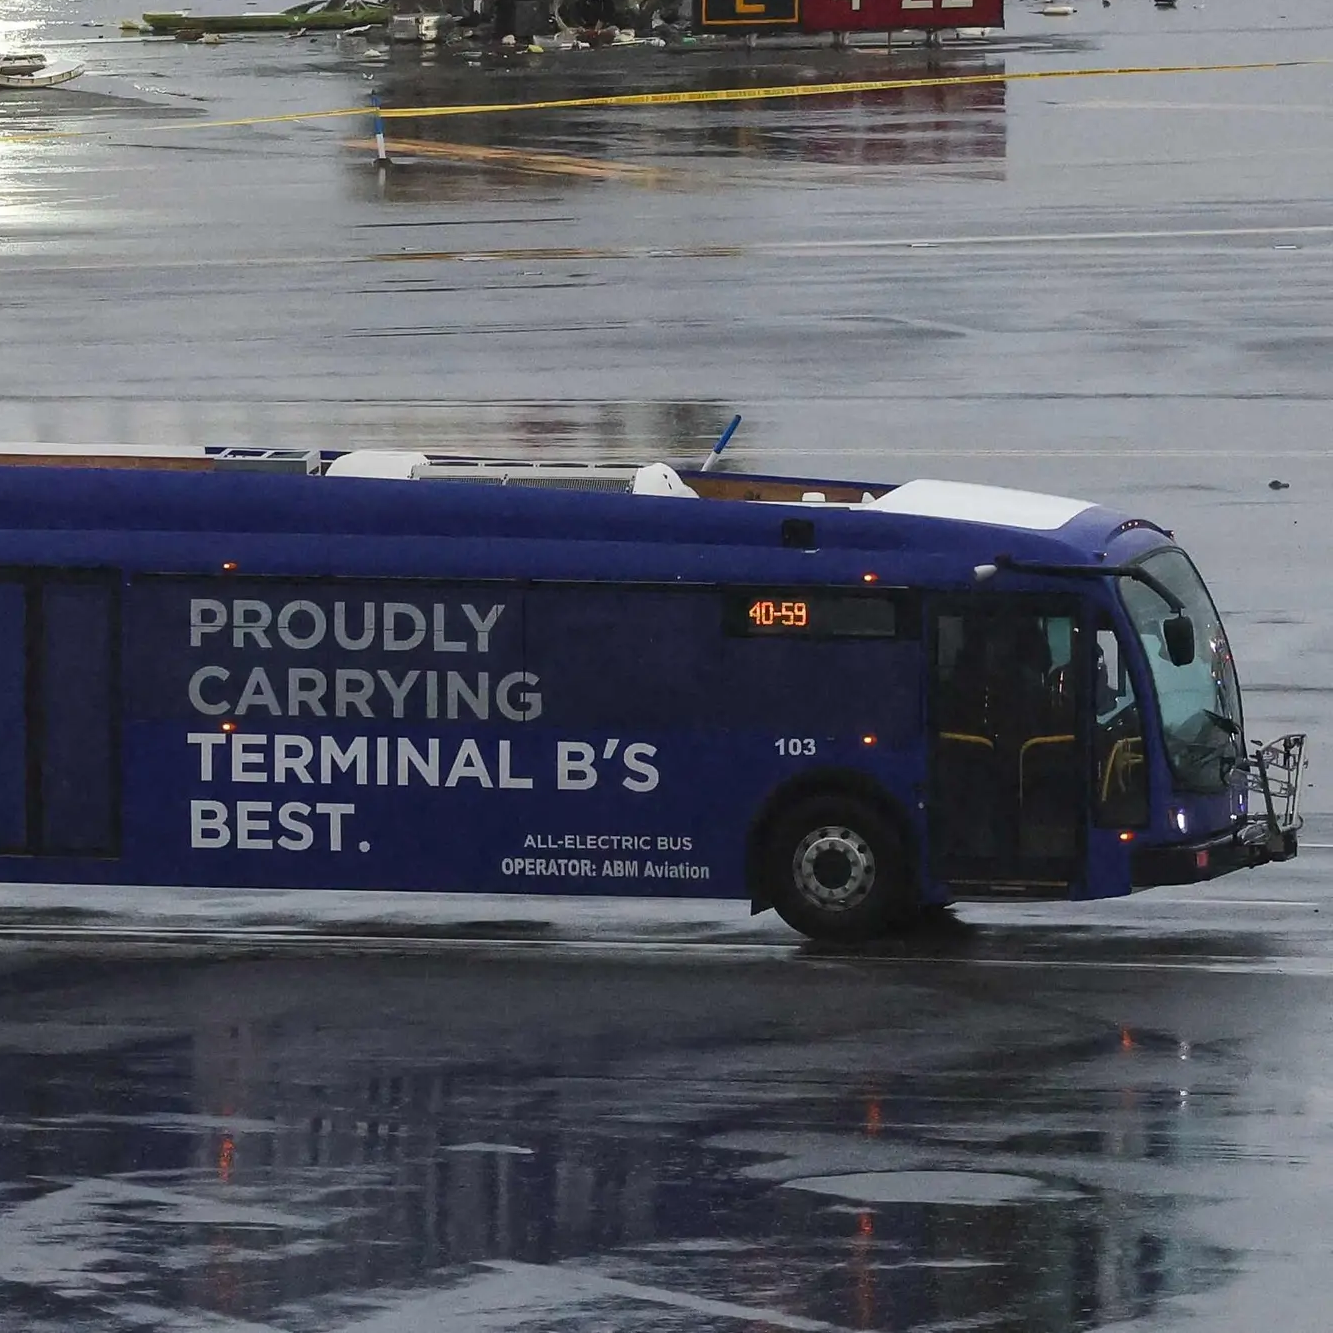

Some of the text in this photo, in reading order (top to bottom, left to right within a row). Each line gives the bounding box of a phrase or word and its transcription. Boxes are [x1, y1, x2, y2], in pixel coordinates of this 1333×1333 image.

[190, 599, 505, 653] PROUDLY
[748, 601, 807, 626] 40-59
[188, 666, 543, 722] CARRYING
[187, 732, 660, 793] TERMINAL B'S
[774, 738, 816, 756] 103
[190, 800, 371, 853] BEST.
[524, 834, 693, 850] ALL-ELECTRIC BUS
[501, 858, 710, 879] OPERATOR: ABM Aviation
